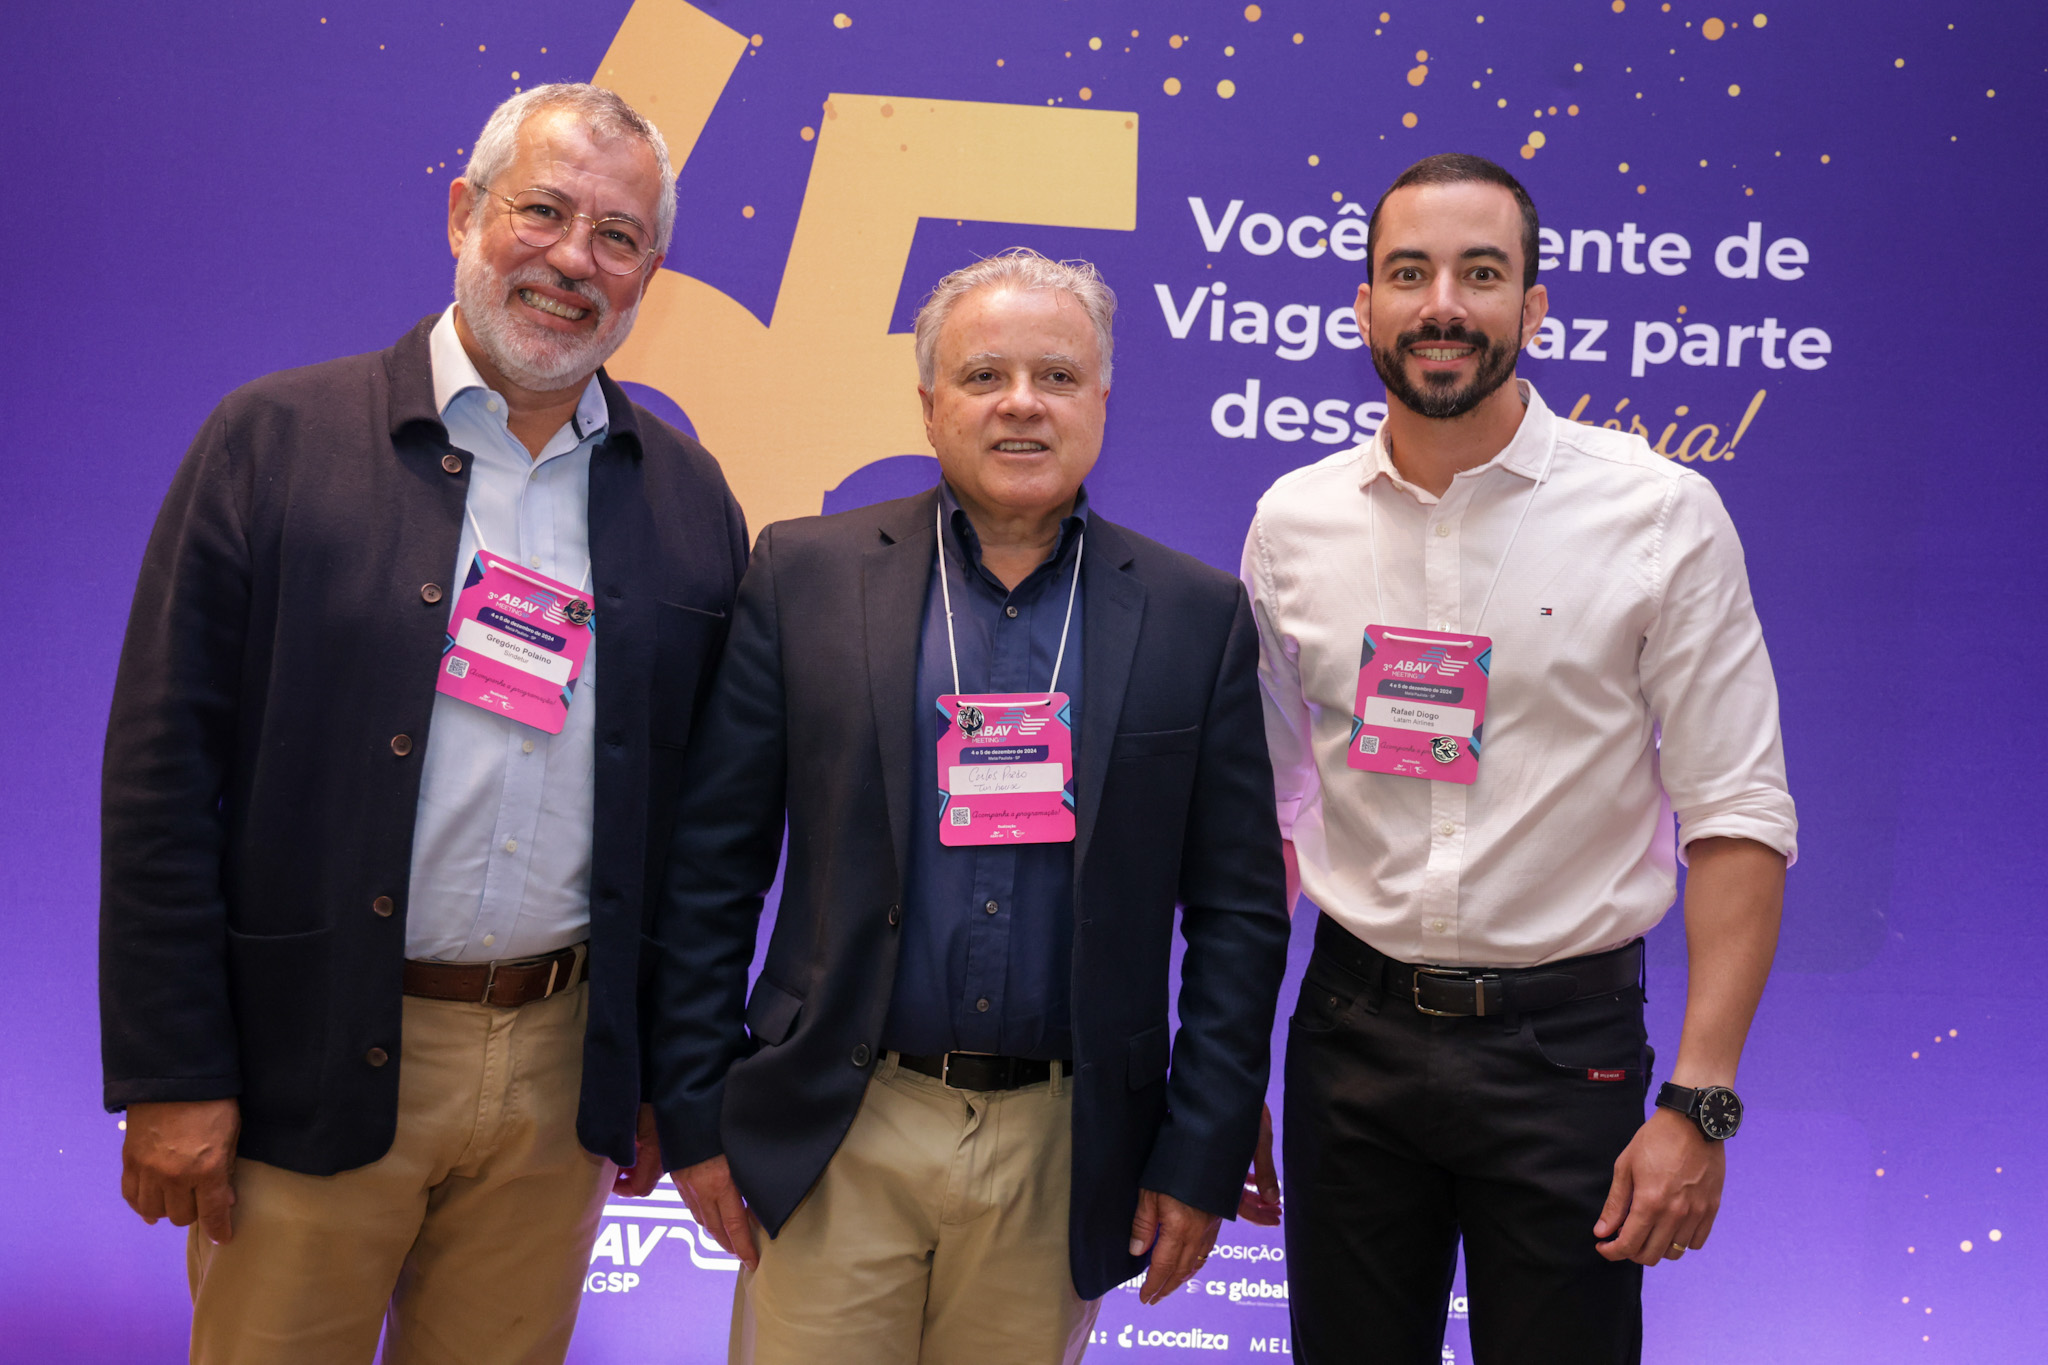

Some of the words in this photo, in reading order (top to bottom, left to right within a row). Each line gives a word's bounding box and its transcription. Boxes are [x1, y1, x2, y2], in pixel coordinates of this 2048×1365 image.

[1188, 197, 1368, 261] Você
[1538, 223, 1691, 276] ente
[1715, 221, 1809, 280] de
[1154, 281, 1363, 361] Viage
[1526, 316, 1608, 361] az
[1631, 317, 1832, 377] parte
[1211, 379, 1388, 444] dess
[499, 593, 541, 614] ABAV
[486, 634, 521, 653] Gregório
[523, 647, 552, 665] Polaino
[504, 650, 529, 664] Sindetur
[1394, 660, 1433, 673] ABAV
[1391, 707, 1415, 717] Rafael
[1416, 710, 1440, 720] Diogo
[1393, 717, 1411, 725] Latam
[1412, 719, 1435, 727] Airlines
[972, 810, 1010, 820] Acompanhe
[1015, 809, 1061, 820] programação!
[590, 1223, 668, 1266] AV
[1208, 1244, 1284, 1263] POSIÇÃO
[583, 1271, 640, 1293] GSP
[1206, 1280, 1226, 1296] cs
[1228, 1277, 1289, 1301] global
[1250, 1337, 1291, 1354] MEL
